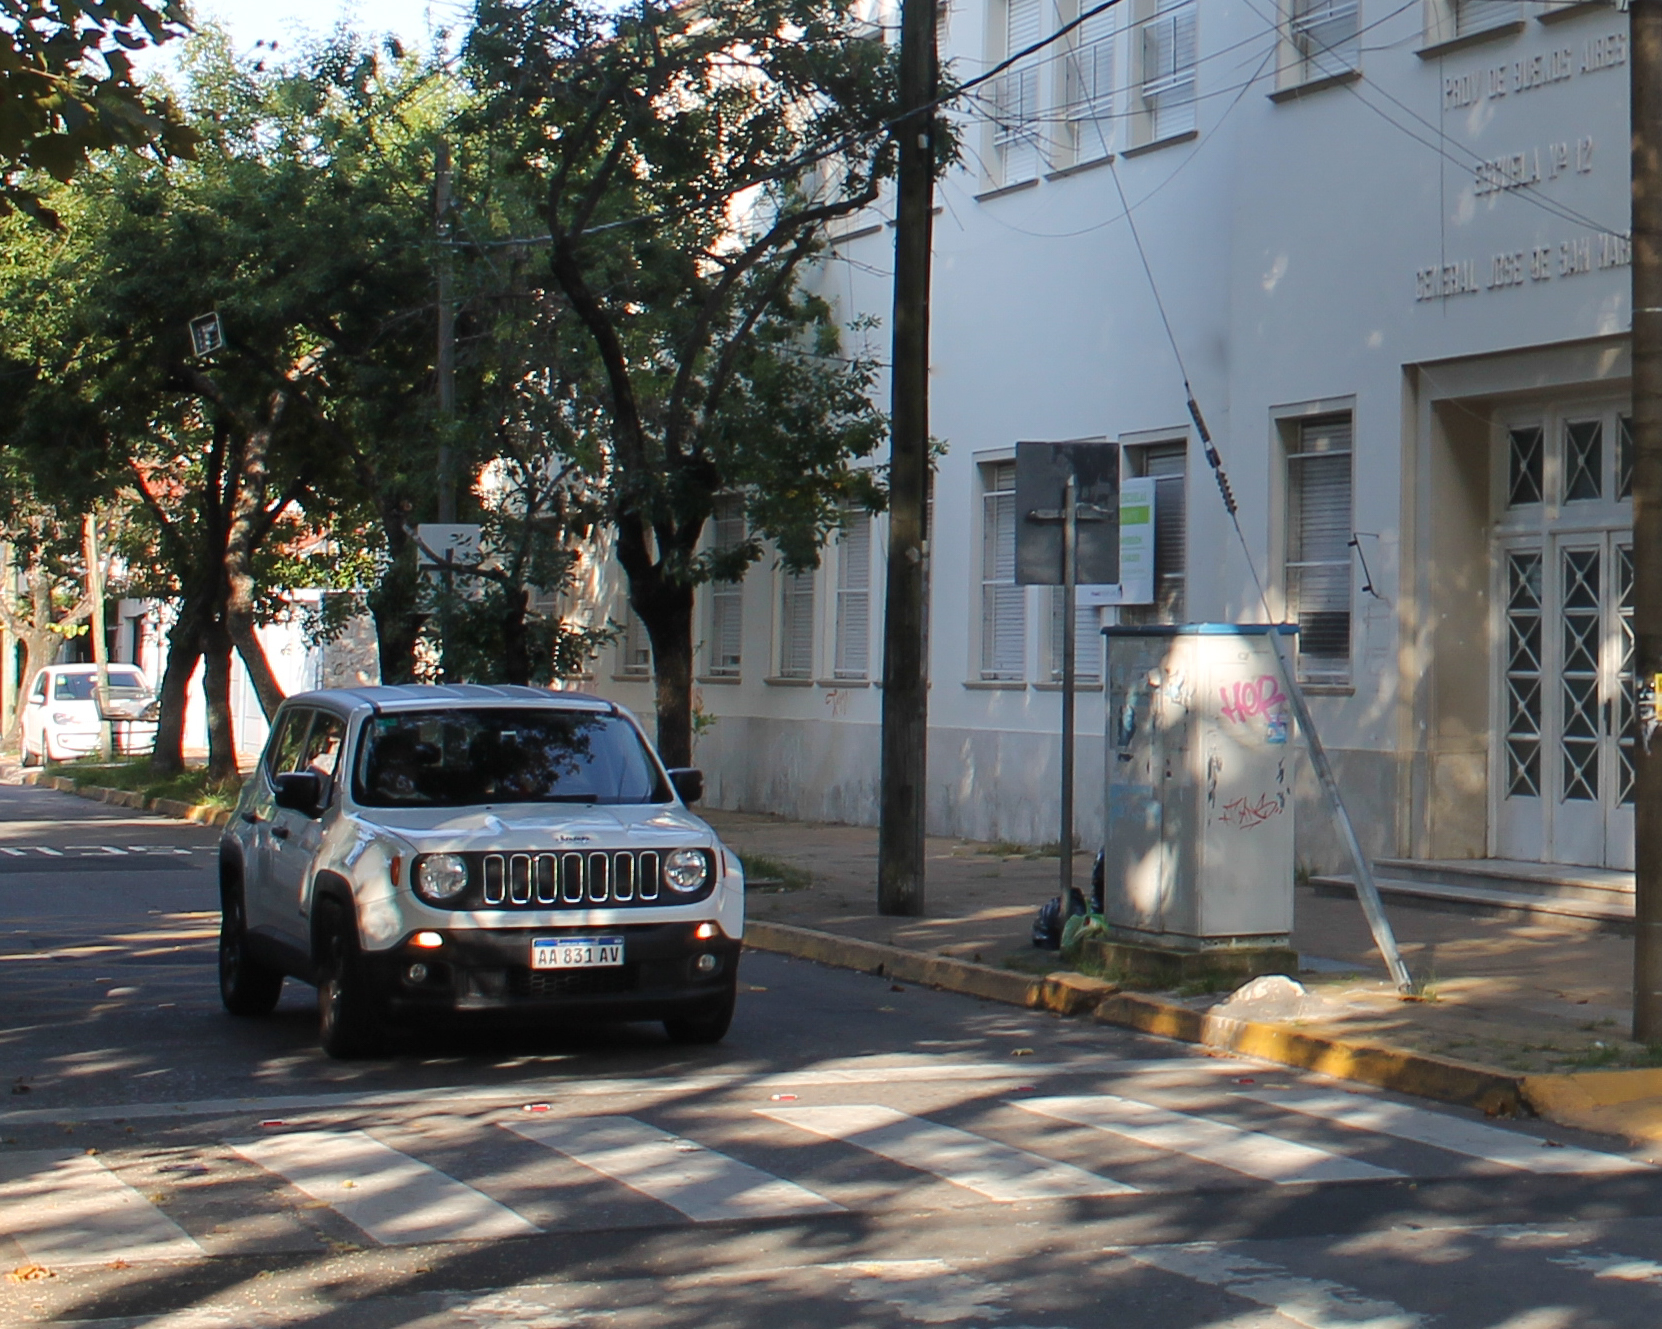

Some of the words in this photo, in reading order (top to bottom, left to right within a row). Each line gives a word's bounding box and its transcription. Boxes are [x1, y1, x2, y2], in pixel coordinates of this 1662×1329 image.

[1489, 65, 1507, 99] DE
[1514, 49, 1571, 93] BUENOS
[1579, 33, 1627, 75] AIRES
[1474, 147, 1541, 197] ESCUELA
[1559, 237, 1591, 278] SAN
[538, 949, 558, 965] AA
[563, 947, 594, 964] 831
[599, 946, 619, 963] AV
